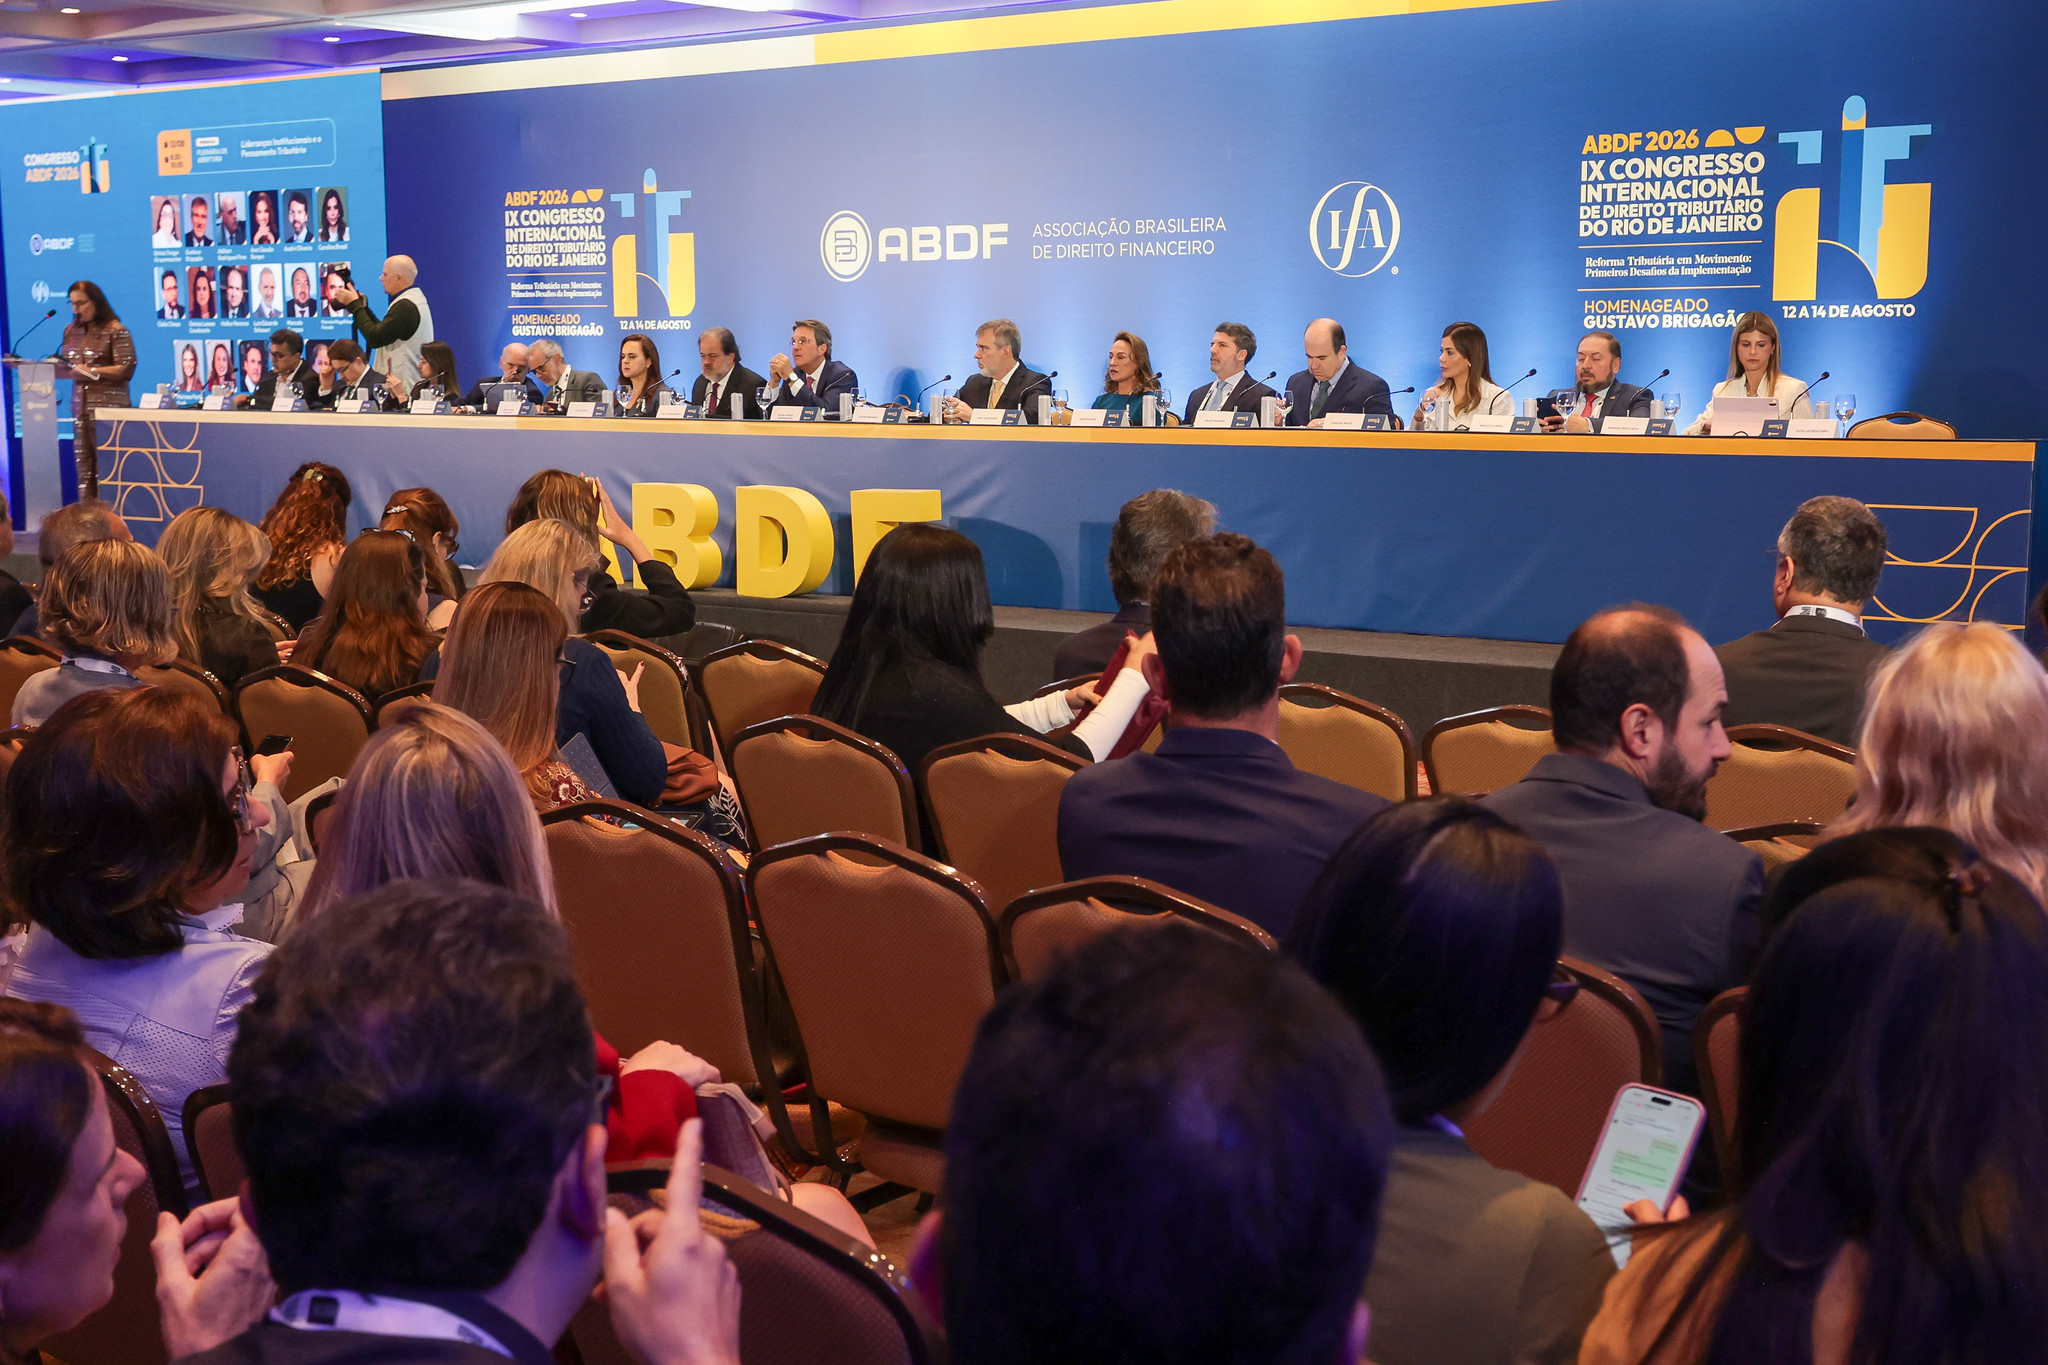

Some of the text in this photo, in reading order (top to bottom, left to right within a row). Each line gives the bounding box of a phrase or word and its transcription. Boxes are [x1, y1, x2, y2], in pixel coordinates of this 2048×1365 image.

[1582, 129, 1700, 155] ABDF 2026
[23, 151, 80, 166] CONGRESSO
[1580, 151, 1766, 182] IX CONGRESSO
[25, 166, 80, 182] ABDF 2026
[505, 189, 569, 206] ABDF 2026
[1580, 176, 1764, 203] INTERNACIONAL
[1579, 196, 1764, 220] DE DIREITO TRIBUTÁRIO
[505, 207, 605, 227] IX CONGRESSO
[1032, 216, 1227, 240] ASSOCIAÇÃO BRASILEIRA
[1579, 213, 1763, 238] DO RIO DE JANEIRO
[505, 225, 606, 243] INTERNACIONAL
[44, 237, 75, 250] ABDF
[505, 239, 606, 255] DE DIREITO TRIBUTÁRIO
[878, 223, 1009, 262] ABDF
[1032, 240, 1216, 259] DE DIREITO FINANCEIRO
[506, 252, 606, 268] DO RIO DE JANEIRO
[1585, 254, 1752, 268] Reforma Tributária em Movimento:
[1585, 264, 1752, 278] Primeiros Desafios da Implementação
[533, 281, 560, 290] Tributária
[1584, 298, 1709, 314] HOMENAGEADO
[1783, 303, 1916, 320] 12 A 14 DE AGOSTO
[512, 314, 581, 325] HOMENAGEADO
[620, 319, 692, 330] 12 A 14 DE AGOSTO
[1583, 313, 1660, 329] GUSTAVO
[512, 322, 604, 336] GUSTAVO BRIGAGÃO
[585, 477, 942, 598] BDF
